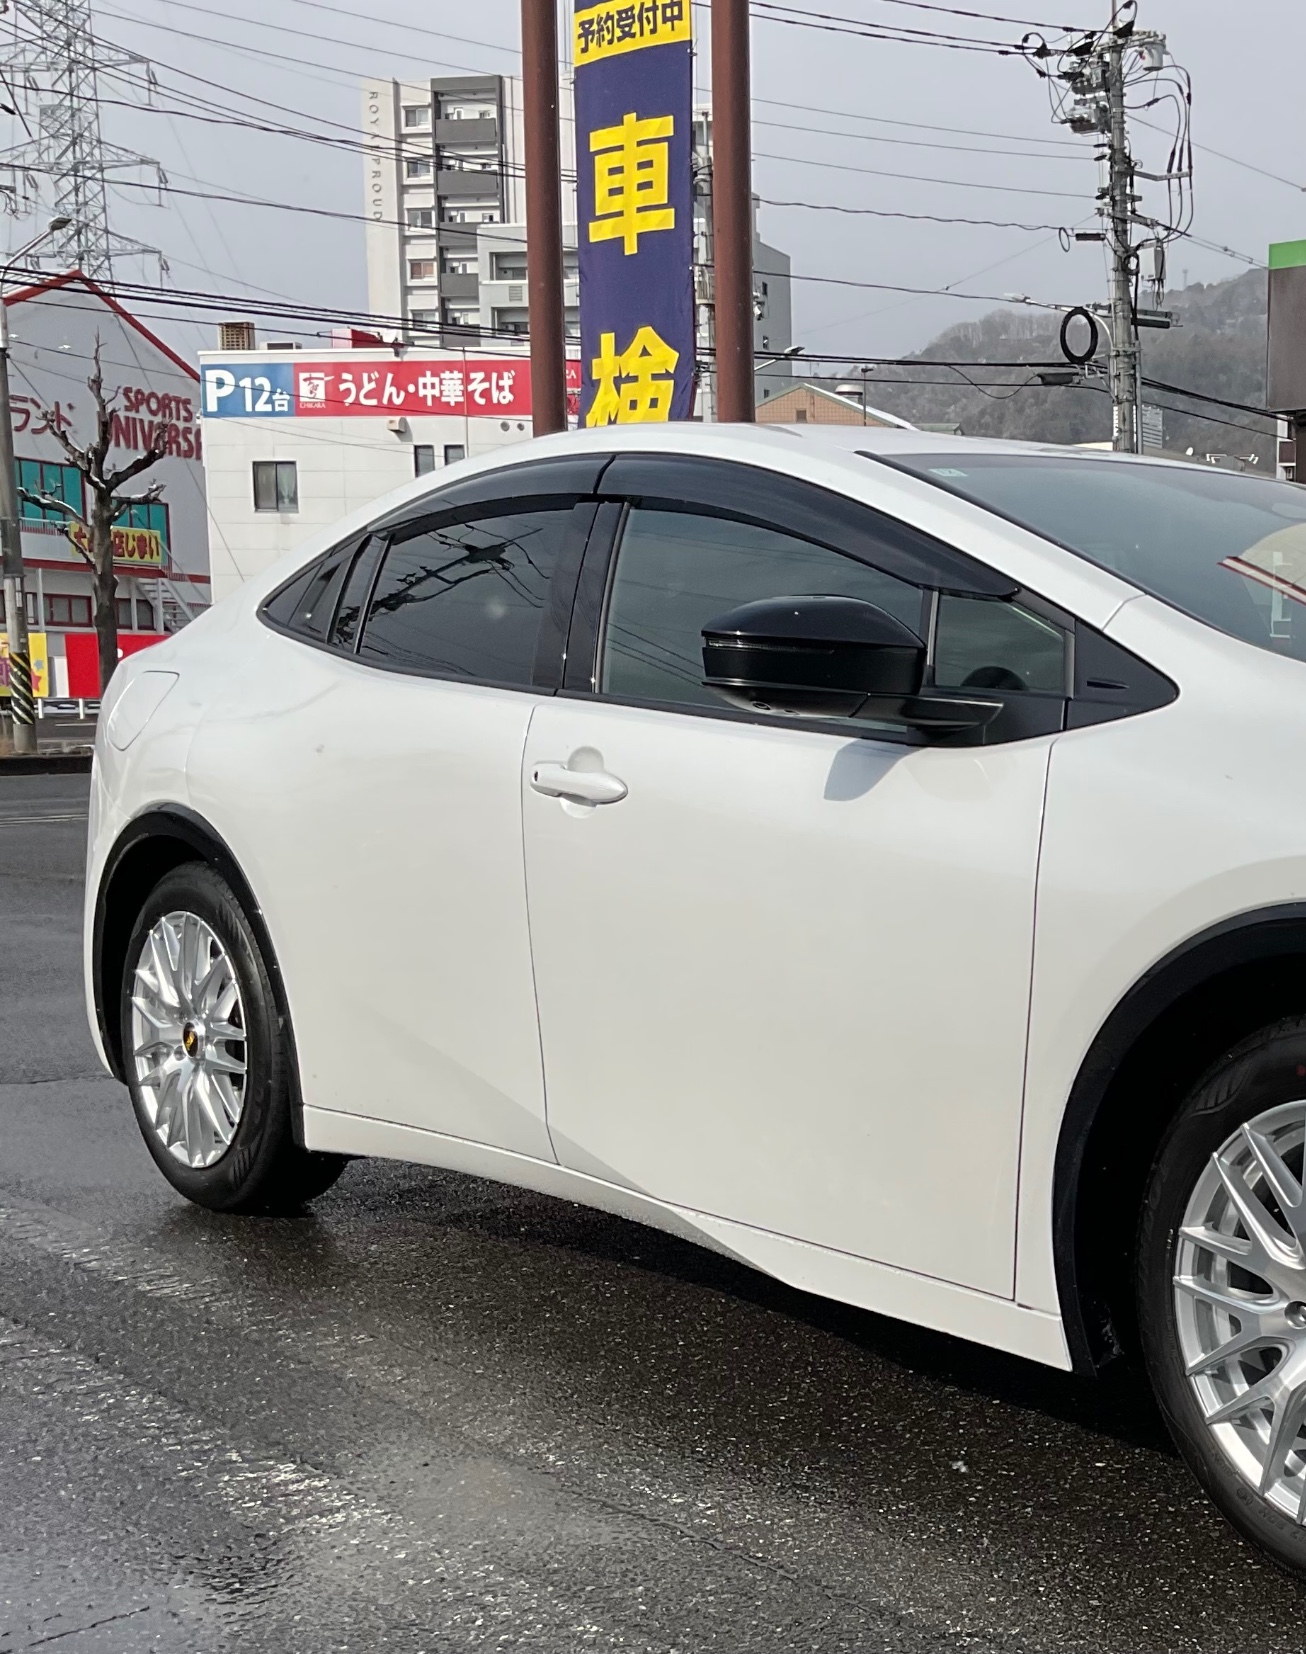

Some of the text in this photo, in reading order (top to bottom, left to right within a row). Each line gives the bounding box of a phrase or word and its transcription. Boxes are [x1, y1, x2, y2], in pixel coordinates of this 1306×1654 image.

[577, 0, 684, 54] 予約受付中
[123, 386, 194, 423] SPORTS
[205, 369, 235, 412] P
[338, 370, 515, 407] うどん・中華そば
